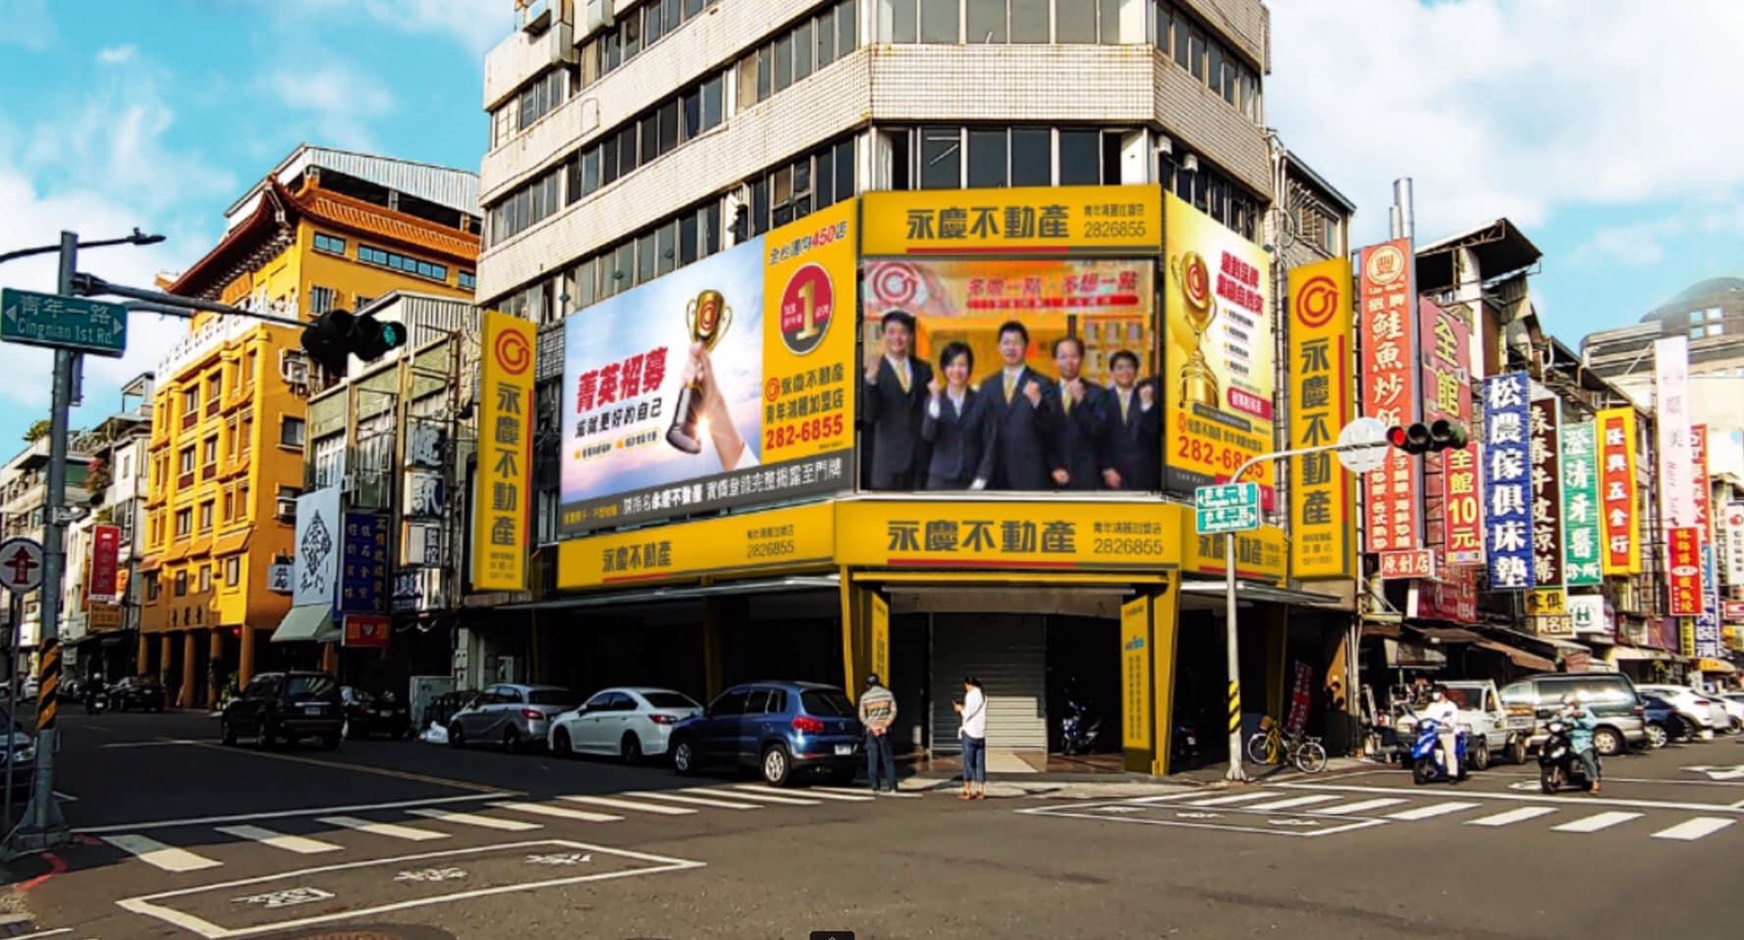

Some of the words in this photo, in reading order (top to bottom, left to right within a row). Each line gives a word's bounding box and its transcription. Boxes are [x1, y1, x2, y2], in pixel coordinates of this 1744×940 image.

[906, 204, 1069, 240] 永慶不動產
[1083, 220, 1147, 238] 2826855
[22, 295, 111, 325] 青年一路
[797, 279, 819, 340] 1
[75, 325, 93, 343] 1st
[577, 346, 669, 413] 菁英招募
[1434, 313, 1460, 417] 全館
[575, 397, 663, 438] 成就更好的自己
[765, 413, 844, 450] 282-6855
[1301, 336, 1331, 525] 永慶不動產
[490, 382, 522, 546] 永慶不動產
[1448, 449, 1479, 549] 全館10元
[887, 519, 1077, 553] 永慶不動產
[1093, 538, 1163, 555] 2826855
[1199, 534, 1263, 565] 永慶動產
[602, 541, 672, 572] 永慶不動產
